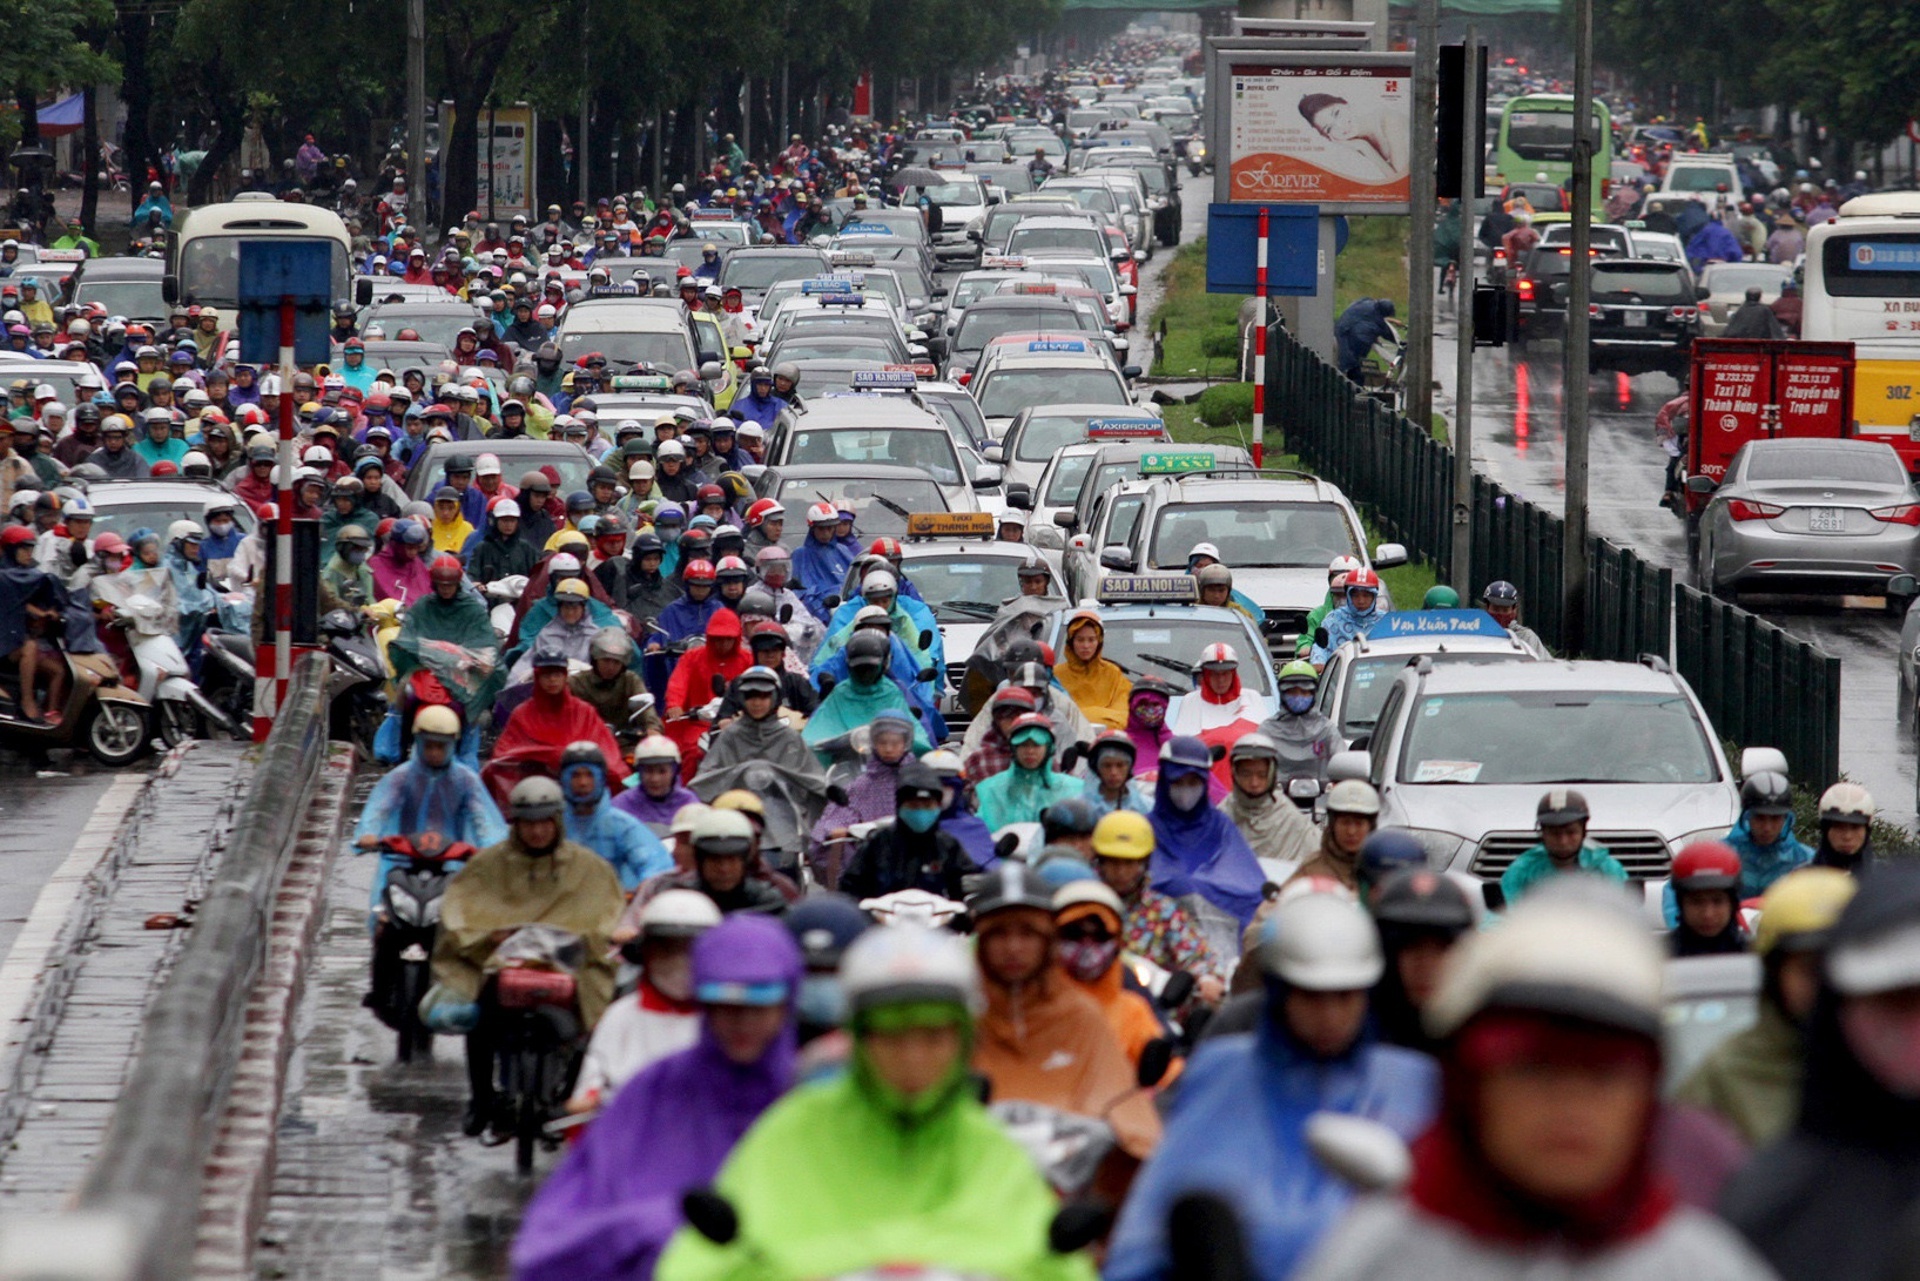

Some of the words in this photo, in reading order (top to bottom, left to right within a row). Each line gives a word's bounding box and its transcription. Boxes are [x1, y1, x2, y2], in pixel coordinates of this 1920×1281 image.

[1236, 161, 1321, 189] FOREVER
[1858, 248, 1873, 262] 01
[857, 373, 874, 381] SAO
[875, 373, 901, 381] HANOI
[1714, 384, 1735, 397] Taxi
[1886, 385, 1913, 400] 30Z
[1703, 398, 1733, 412] Thành
[1165, 460, 1211, 468] TAXI
[972, 523, 992, 531] NGA
[1106, 579, 1130, 592] SAO
[1133, 579, 1172, 592] HANOI
